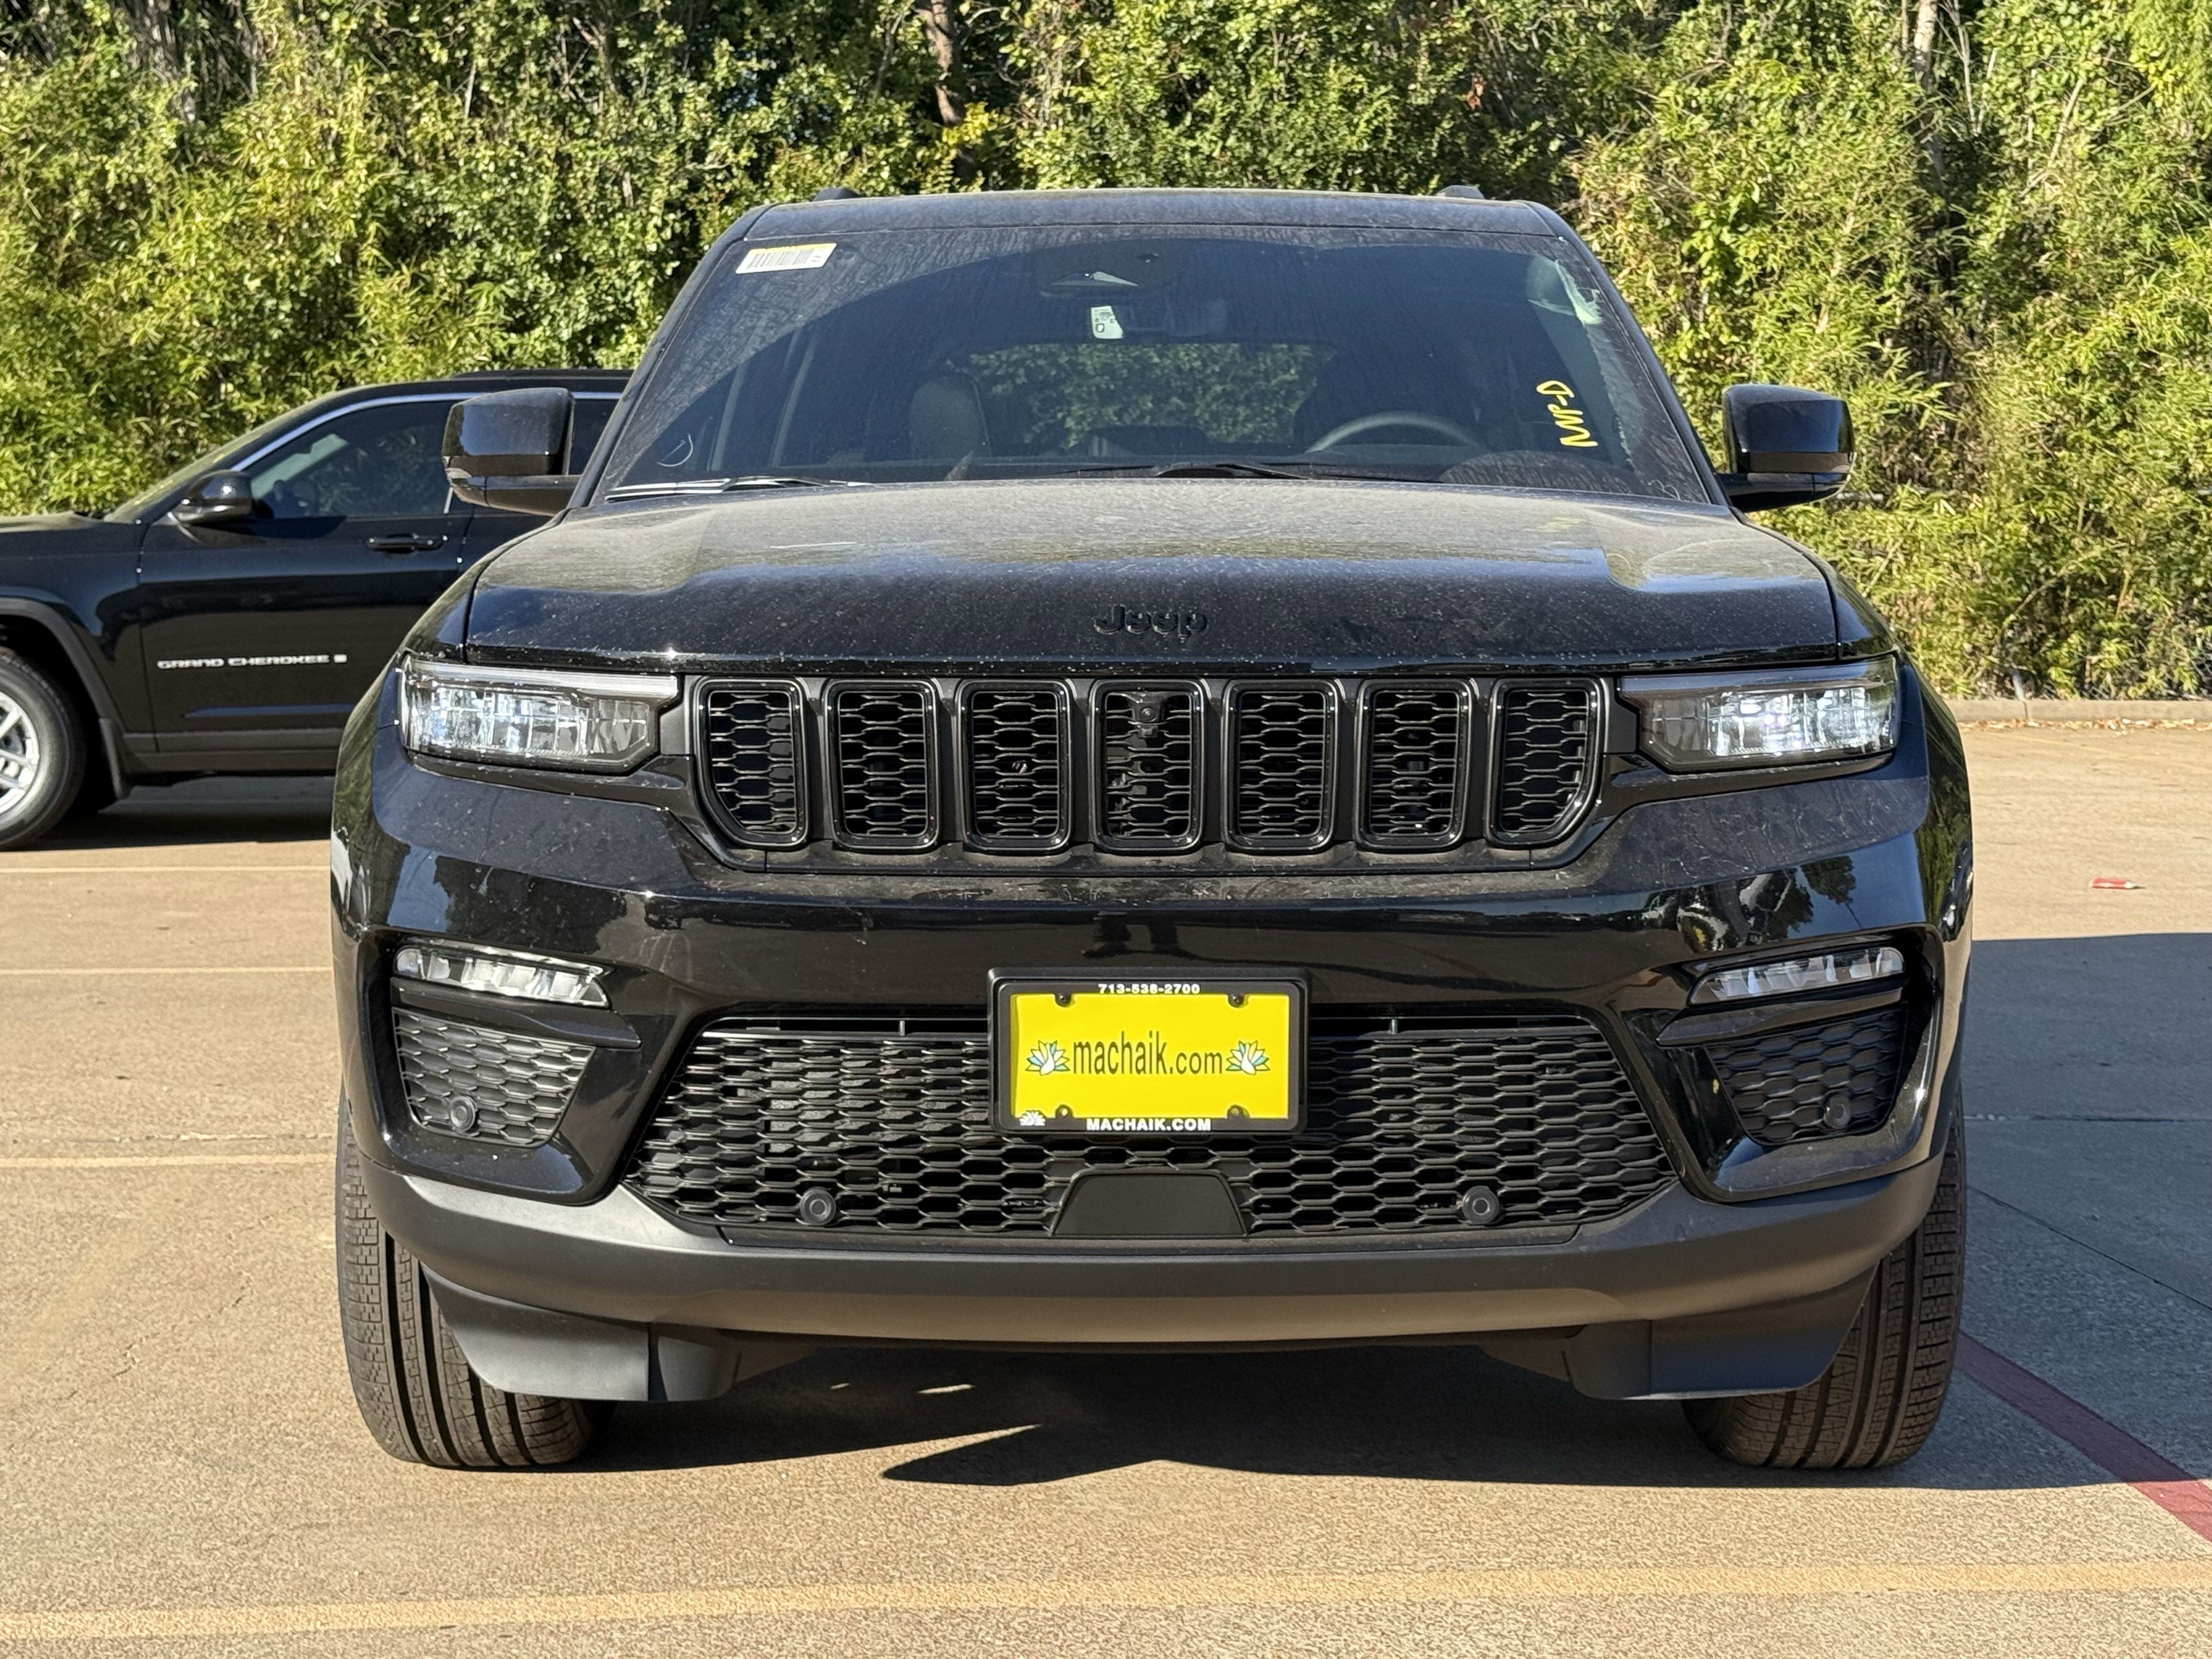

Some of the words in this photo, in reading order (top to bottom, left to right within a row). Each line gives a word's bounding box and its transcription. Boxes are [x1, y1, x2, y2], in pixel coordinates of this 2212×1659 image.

[1094, 603, 1207, 639] Jeep
[157, 658, 224, 669] GRAND
[227, 654, 330, 666] CHEROKEE
[1073, 1030, 1223, 1075] machaik.com
[1086, 1118, 1211, 1131] MACHAIK.COM
